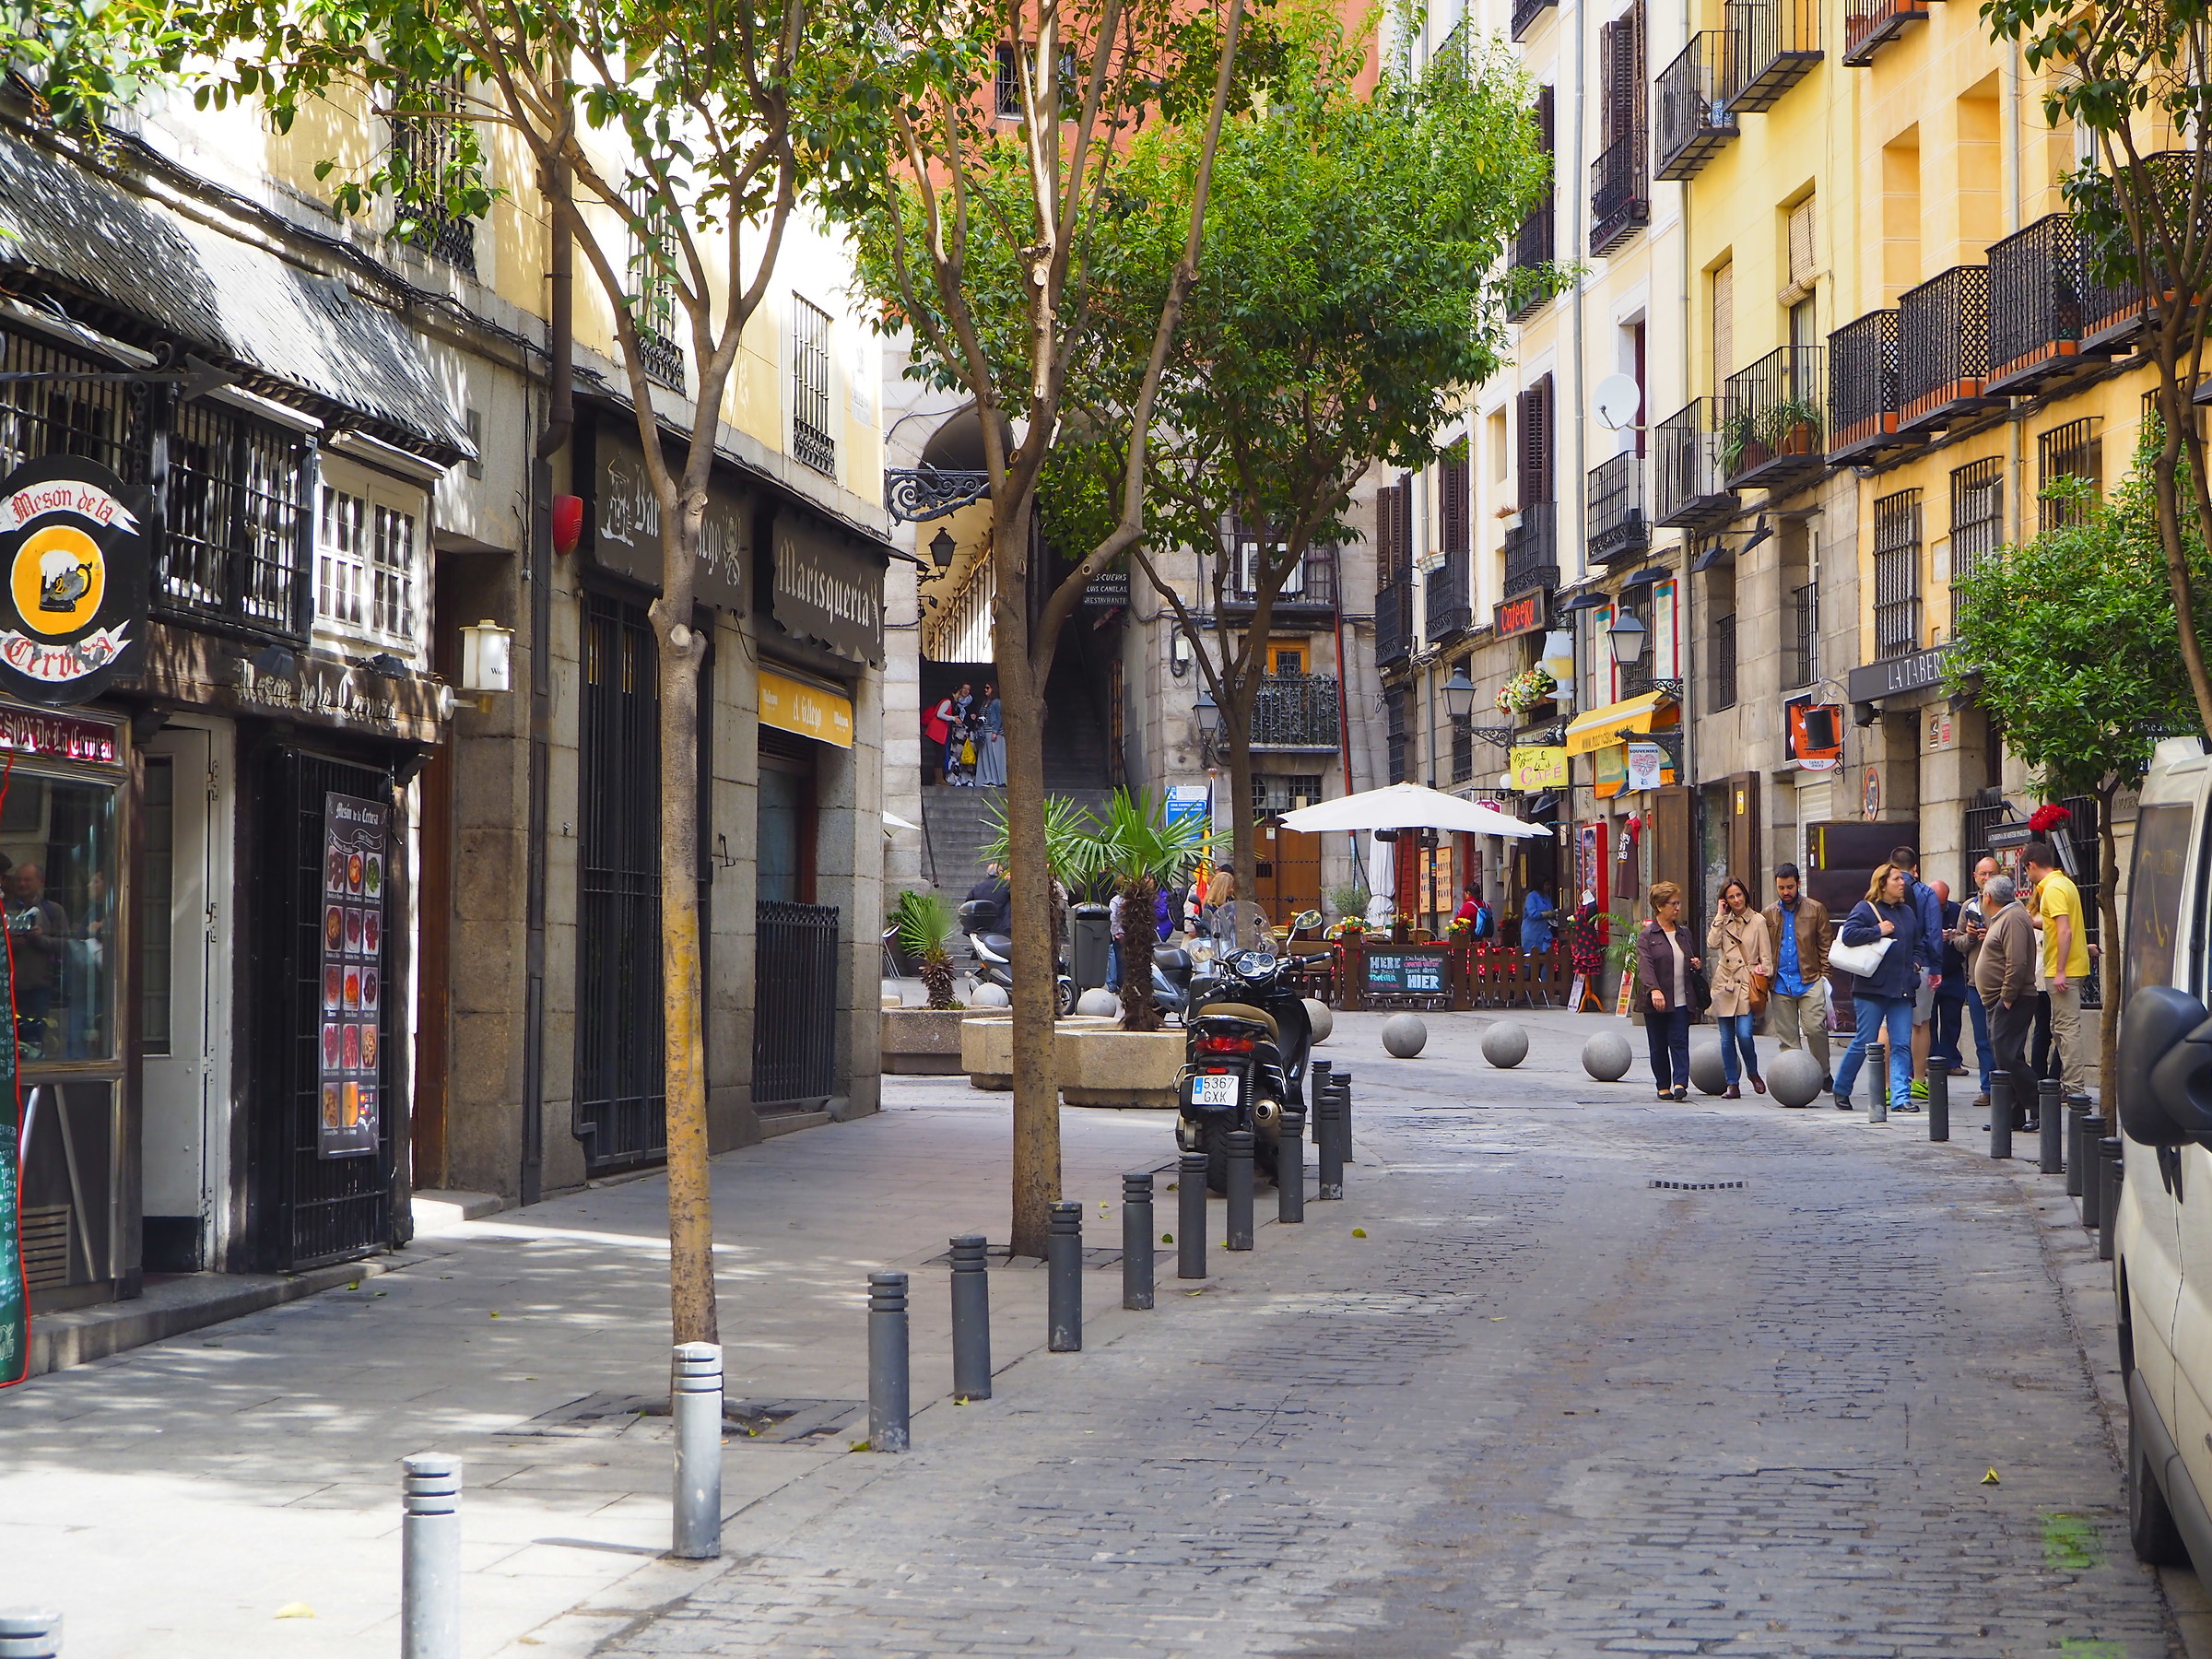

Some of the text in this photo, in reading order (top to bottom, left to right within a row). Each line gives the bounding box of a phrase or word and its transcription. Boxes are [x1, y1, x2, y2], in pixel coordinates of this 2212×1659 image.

[77, 486, 96, 512] de
[778, 536, 871, 629] Marisquería
[1887, 664, 1903, 690] LA
[1521, 761, 1562, 785] CAFÉ
[1370, 957, 1401, 970] HERE
[1406, 974, 1440, 989] HIER
[1204, 1077, 1235, 1089] 5367
[1204, 1090, 1227, 1103] GXK
